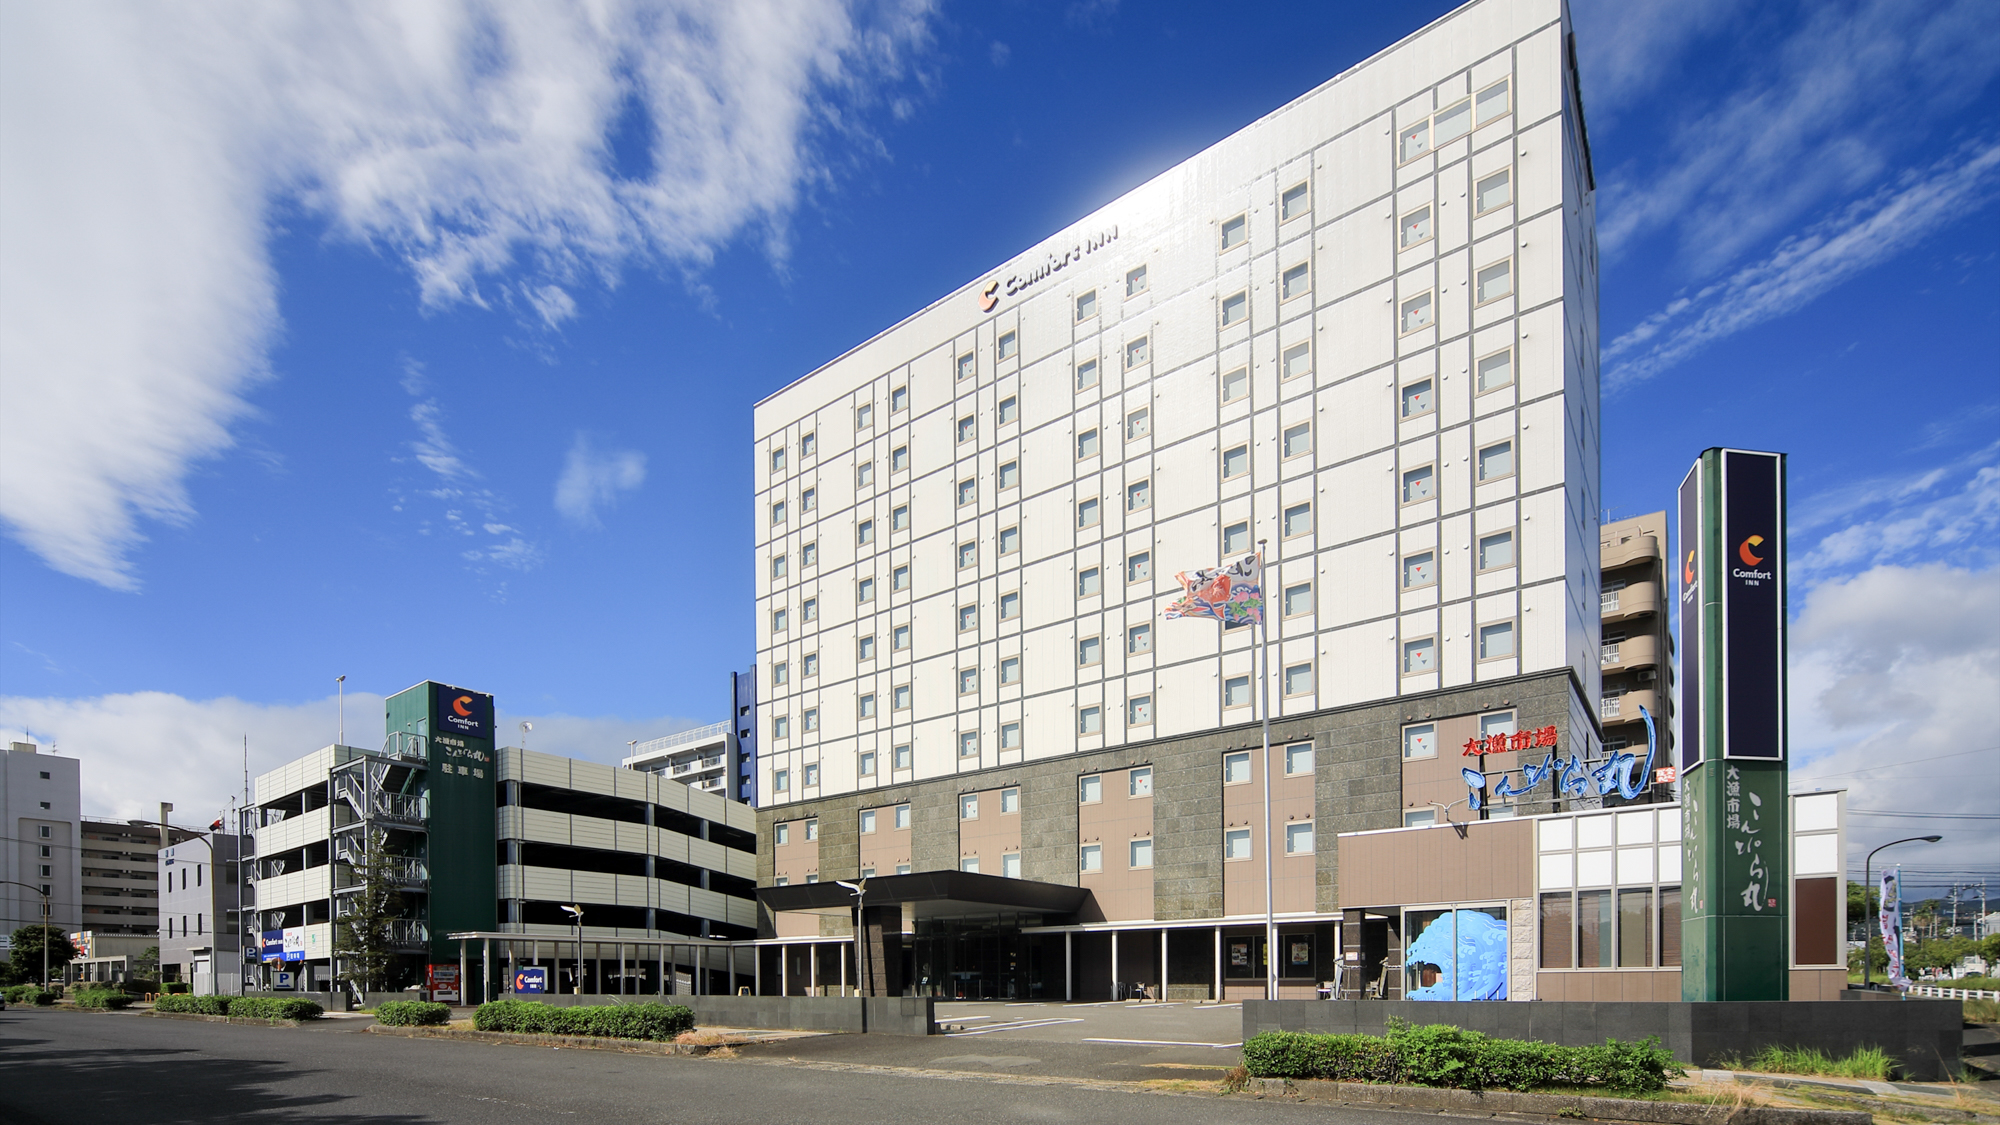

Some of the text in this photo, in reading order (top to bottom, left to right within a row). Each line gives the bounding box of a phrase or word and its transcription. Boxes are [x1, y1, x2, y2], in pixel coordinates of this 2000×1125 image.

[1003, 224, 1119, 296] Comfort INN
[1733, 568, 1771, 580] Comfort
[447, 715, 479, 727] Comfort
[1462, 725, 1558, 757] 大漁市場
[441, 763, 484, 779] 駐車場
[1726, 765, 1741, 829] 大漁市場
[280, 973, 289, 983] P
[524, 975, 542, 984] Comfort
